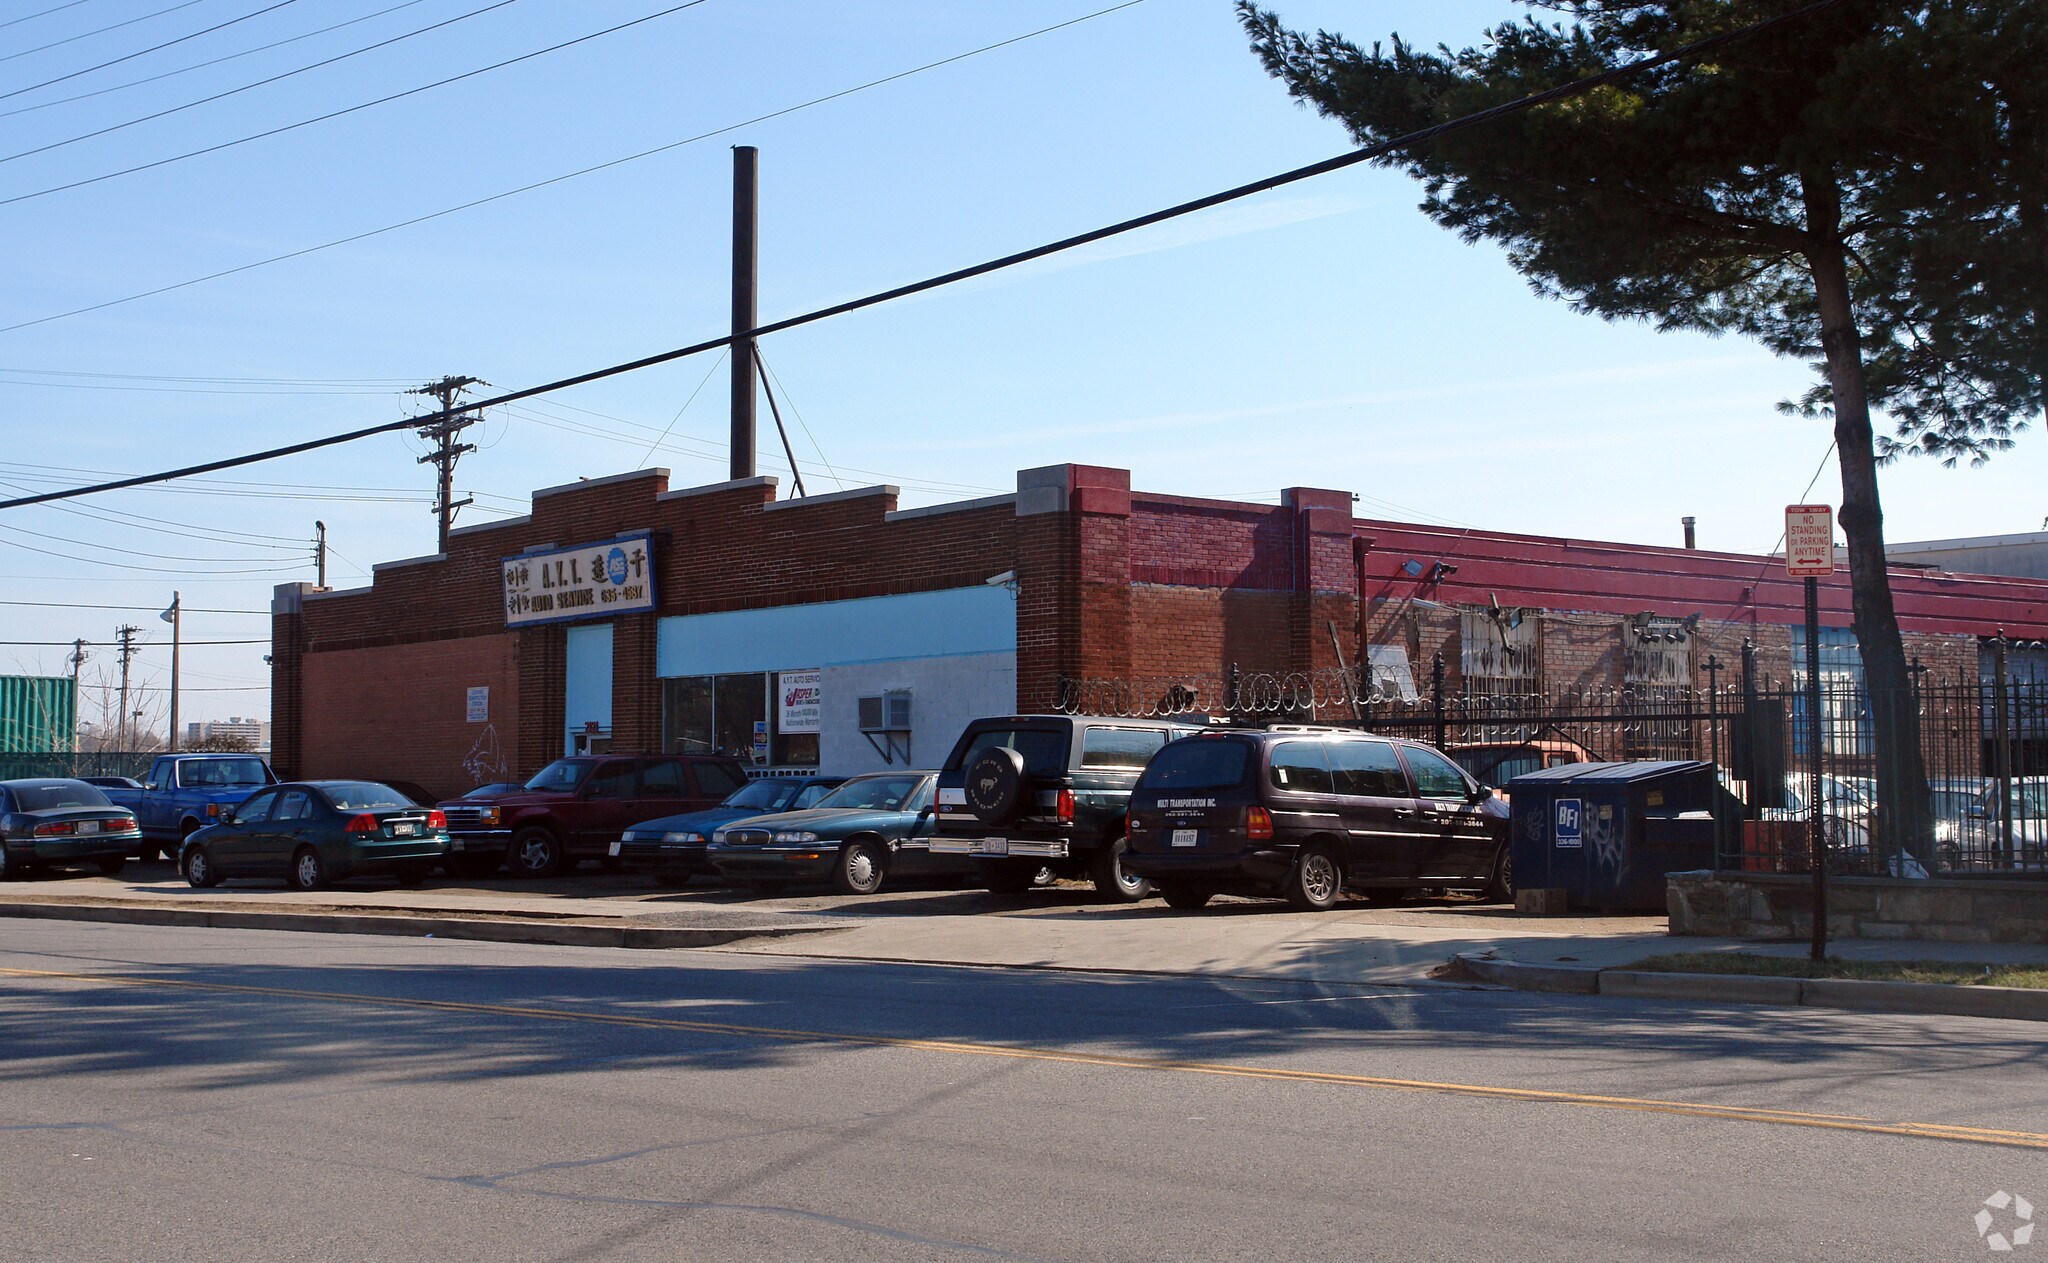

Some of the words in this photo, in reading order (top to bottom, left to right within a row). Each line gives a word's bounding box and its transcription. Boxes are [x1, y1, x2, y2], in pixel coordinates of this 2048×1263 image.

[1803, 516, 1814, 525] NO
[1791, 526, 1827, 535] STANDING
[1800, 536, 1829, 546] PARKING
[1794, 547, 1826, 556] ANYTIME
[542, 558, 582, 589] A.Y.T.
[531, 594, 554, 612] AUTO
[557, 588, 595, 609] SERVICE
[976, 759, 1003, 773] FORD
[970, 788, 1004, 810] BRONCO
[1157, 799, 1169, 808] MULTI
[1169, 798, 1206, 808] TRANSPORTATION
[1559, 806, 1578, 829] BFI
